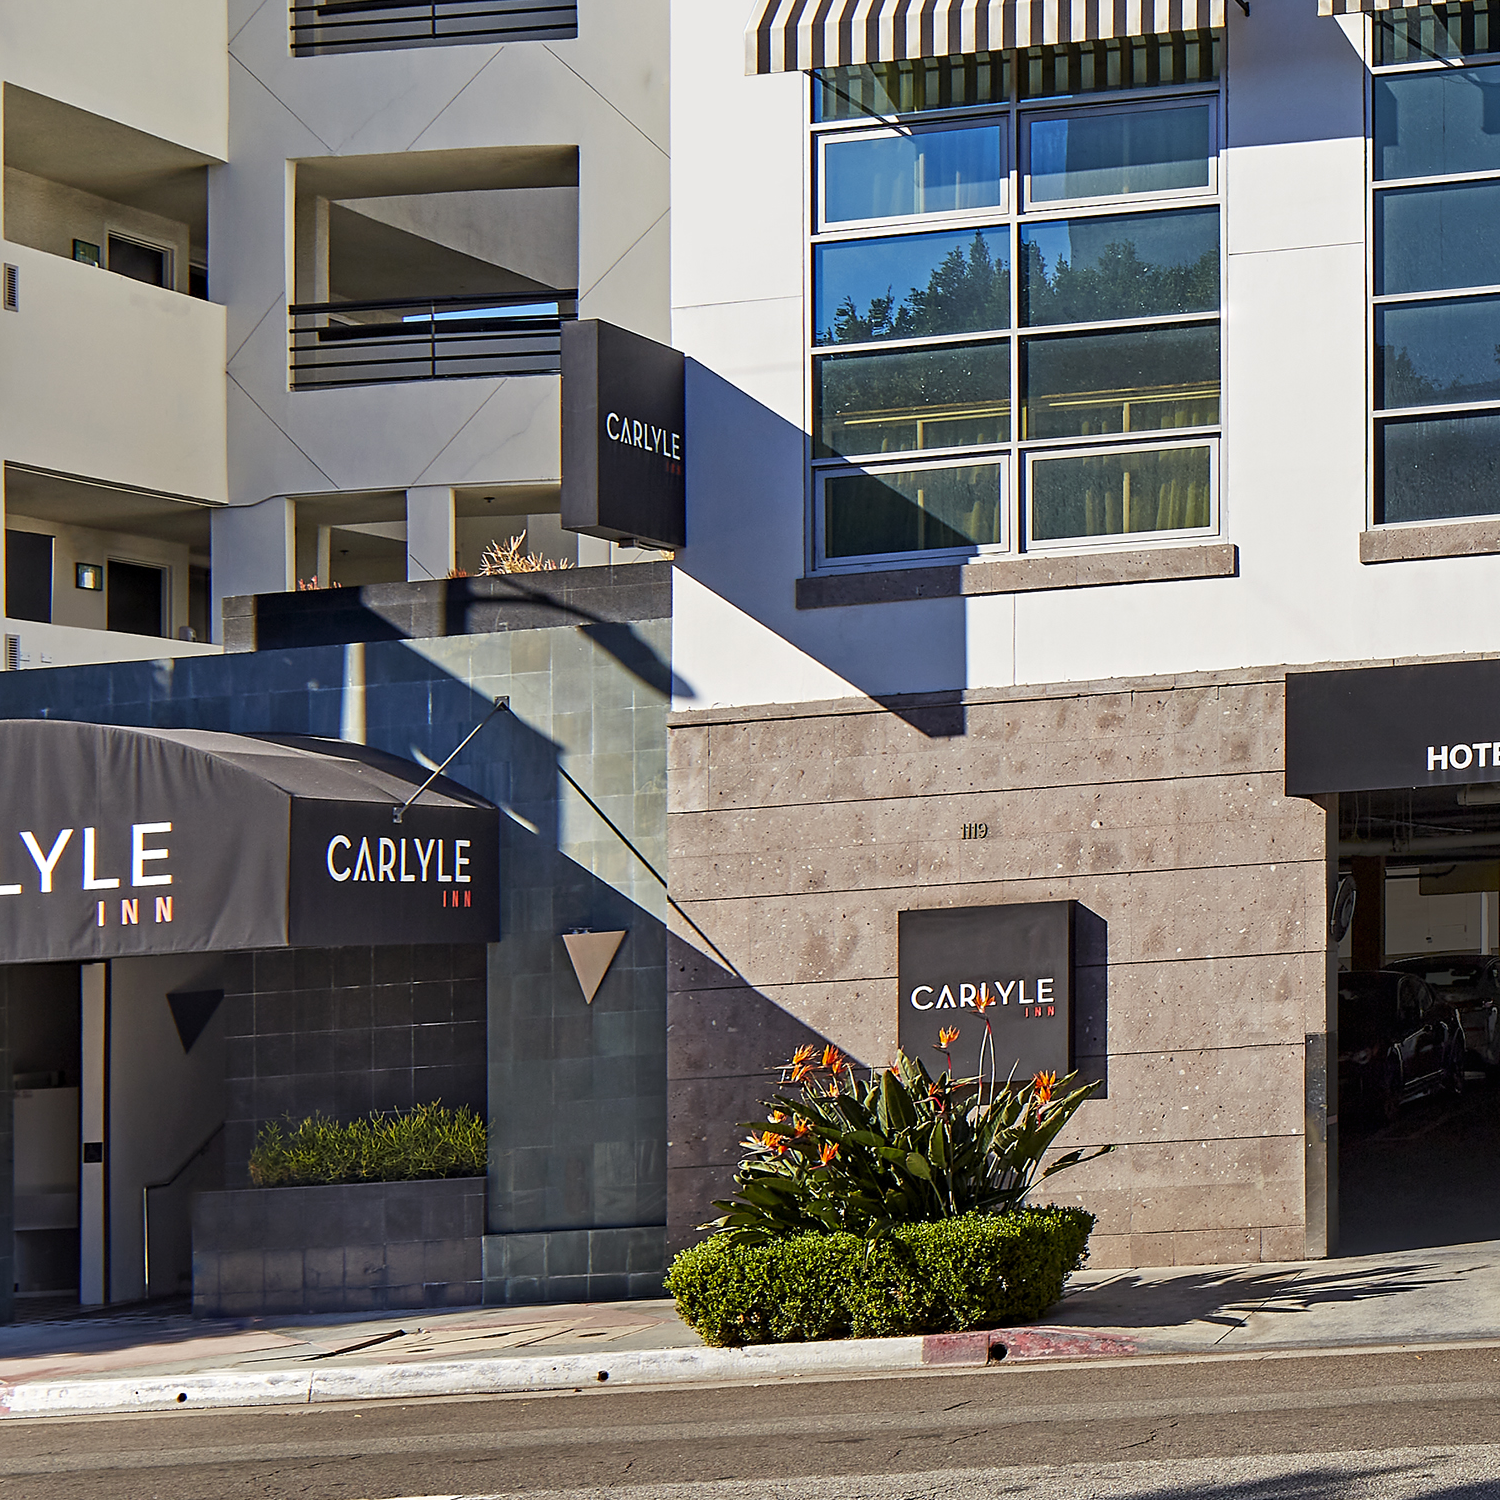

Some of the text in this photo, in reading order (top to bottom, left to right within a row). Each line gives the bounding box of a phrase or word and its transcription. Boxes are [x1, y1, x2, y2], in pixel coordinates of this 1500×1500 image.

[606, 412, 681, 460] CARLYLE
[960, 822, 988, 840] 1119
[326, 834, 471, 882] CARLYLE
[98, 896, 173, 927] INN
[443, 890, 471, 907] INN
[911, 978, 1055, 1011] CARLYLE
[1025, 1006, 1055, 1018] INN
